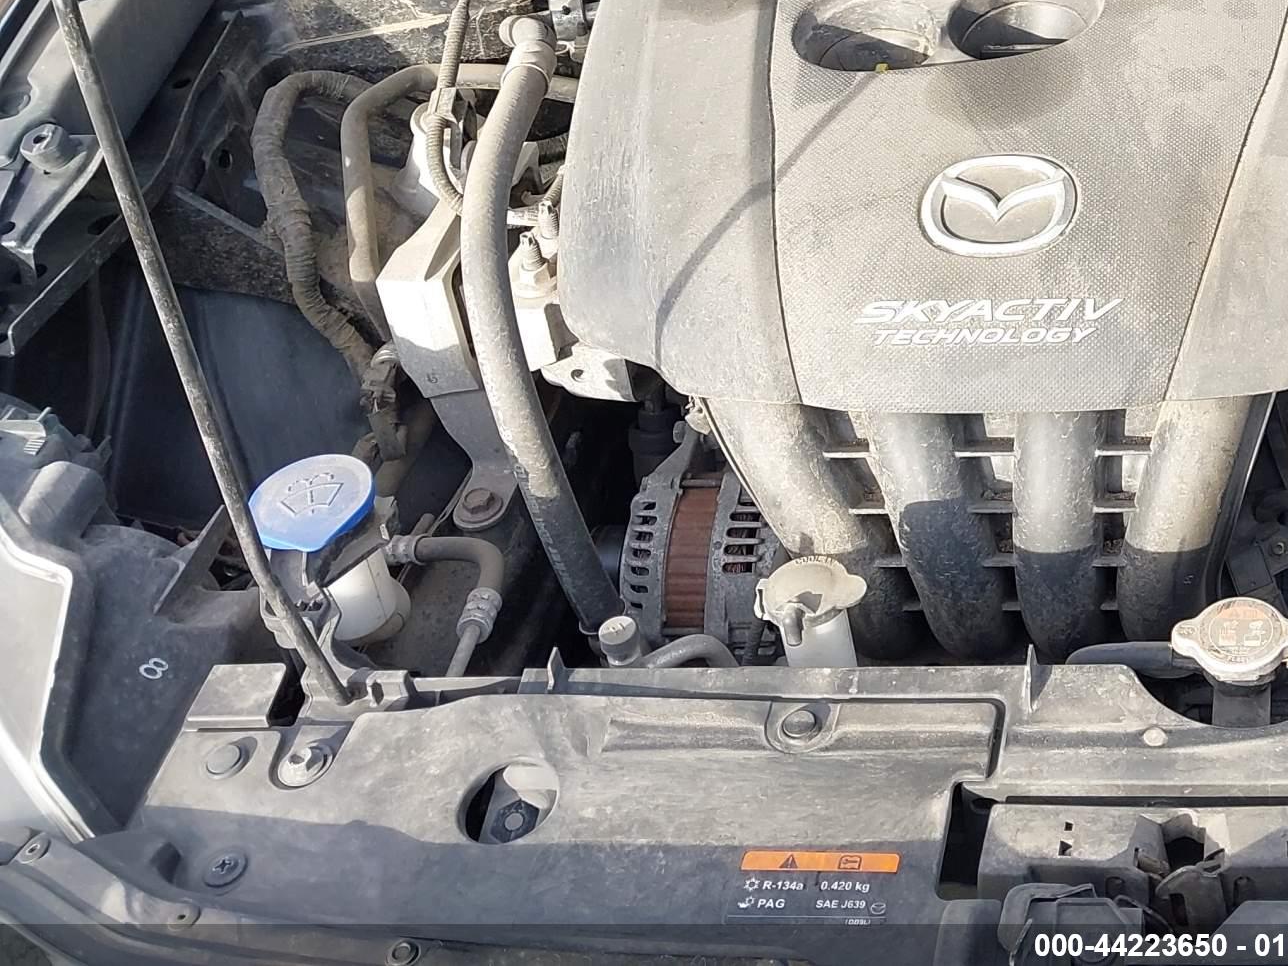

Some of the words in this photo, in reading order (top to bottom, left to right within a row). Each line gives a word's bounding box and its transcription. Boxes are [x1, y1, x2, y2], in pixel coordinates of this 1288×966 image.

[856, 298, 1125, 324] SKYACTIV
[873, 327, 1098, 346] TECHNOLOGY
[762, 880, 804, 890] R-134a
[820, 881, 852, 891] 0.420
[855, 882, 870, 893] kg
[757, 898, 785, 909] PAG
[815, 899, 839, 909] SAE
[841, 900, 866, 909] J639
